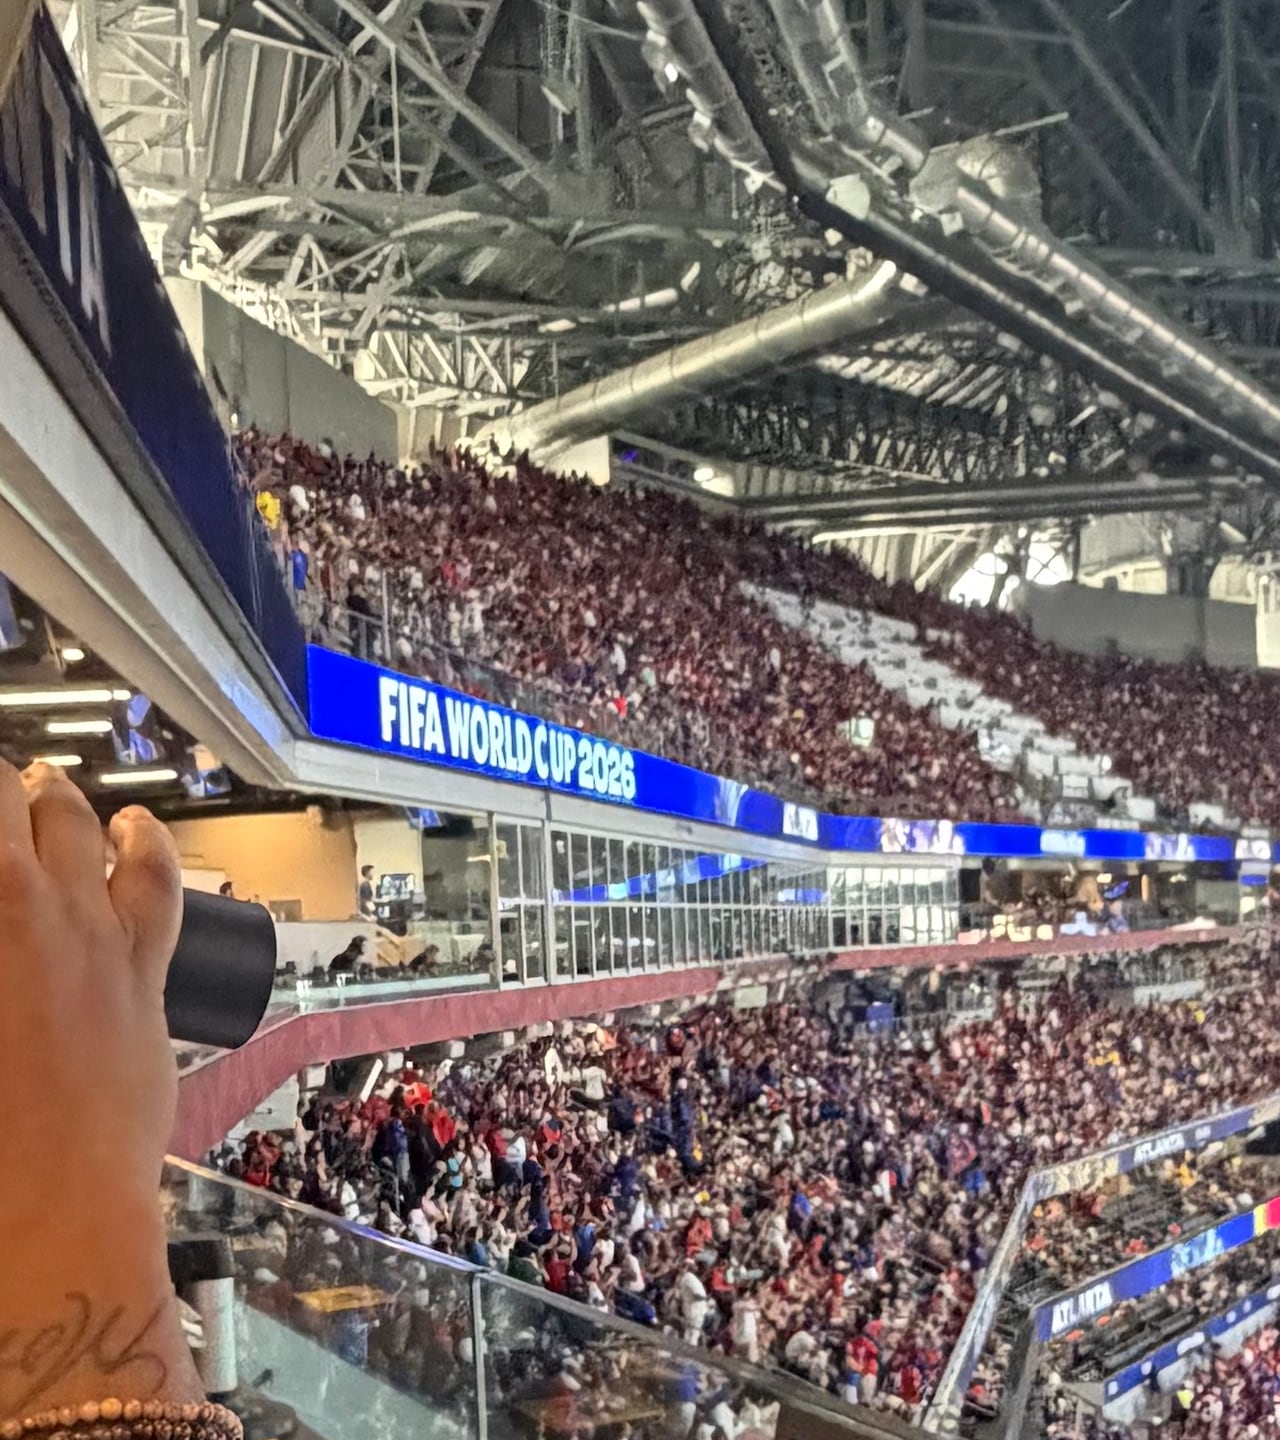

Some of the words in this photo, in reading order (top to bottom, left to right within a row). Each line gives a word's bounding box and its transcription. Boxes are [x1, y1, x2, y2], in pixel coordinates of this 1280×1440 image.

[379, 676, 445, 754] FIFA
[445, 697, 533, 775] WORLD
[534, 725, 576, 784] CUP
[577, 738, 636, 800] 2026
[1051, 1281, 1113, 1334] ATLANTA
